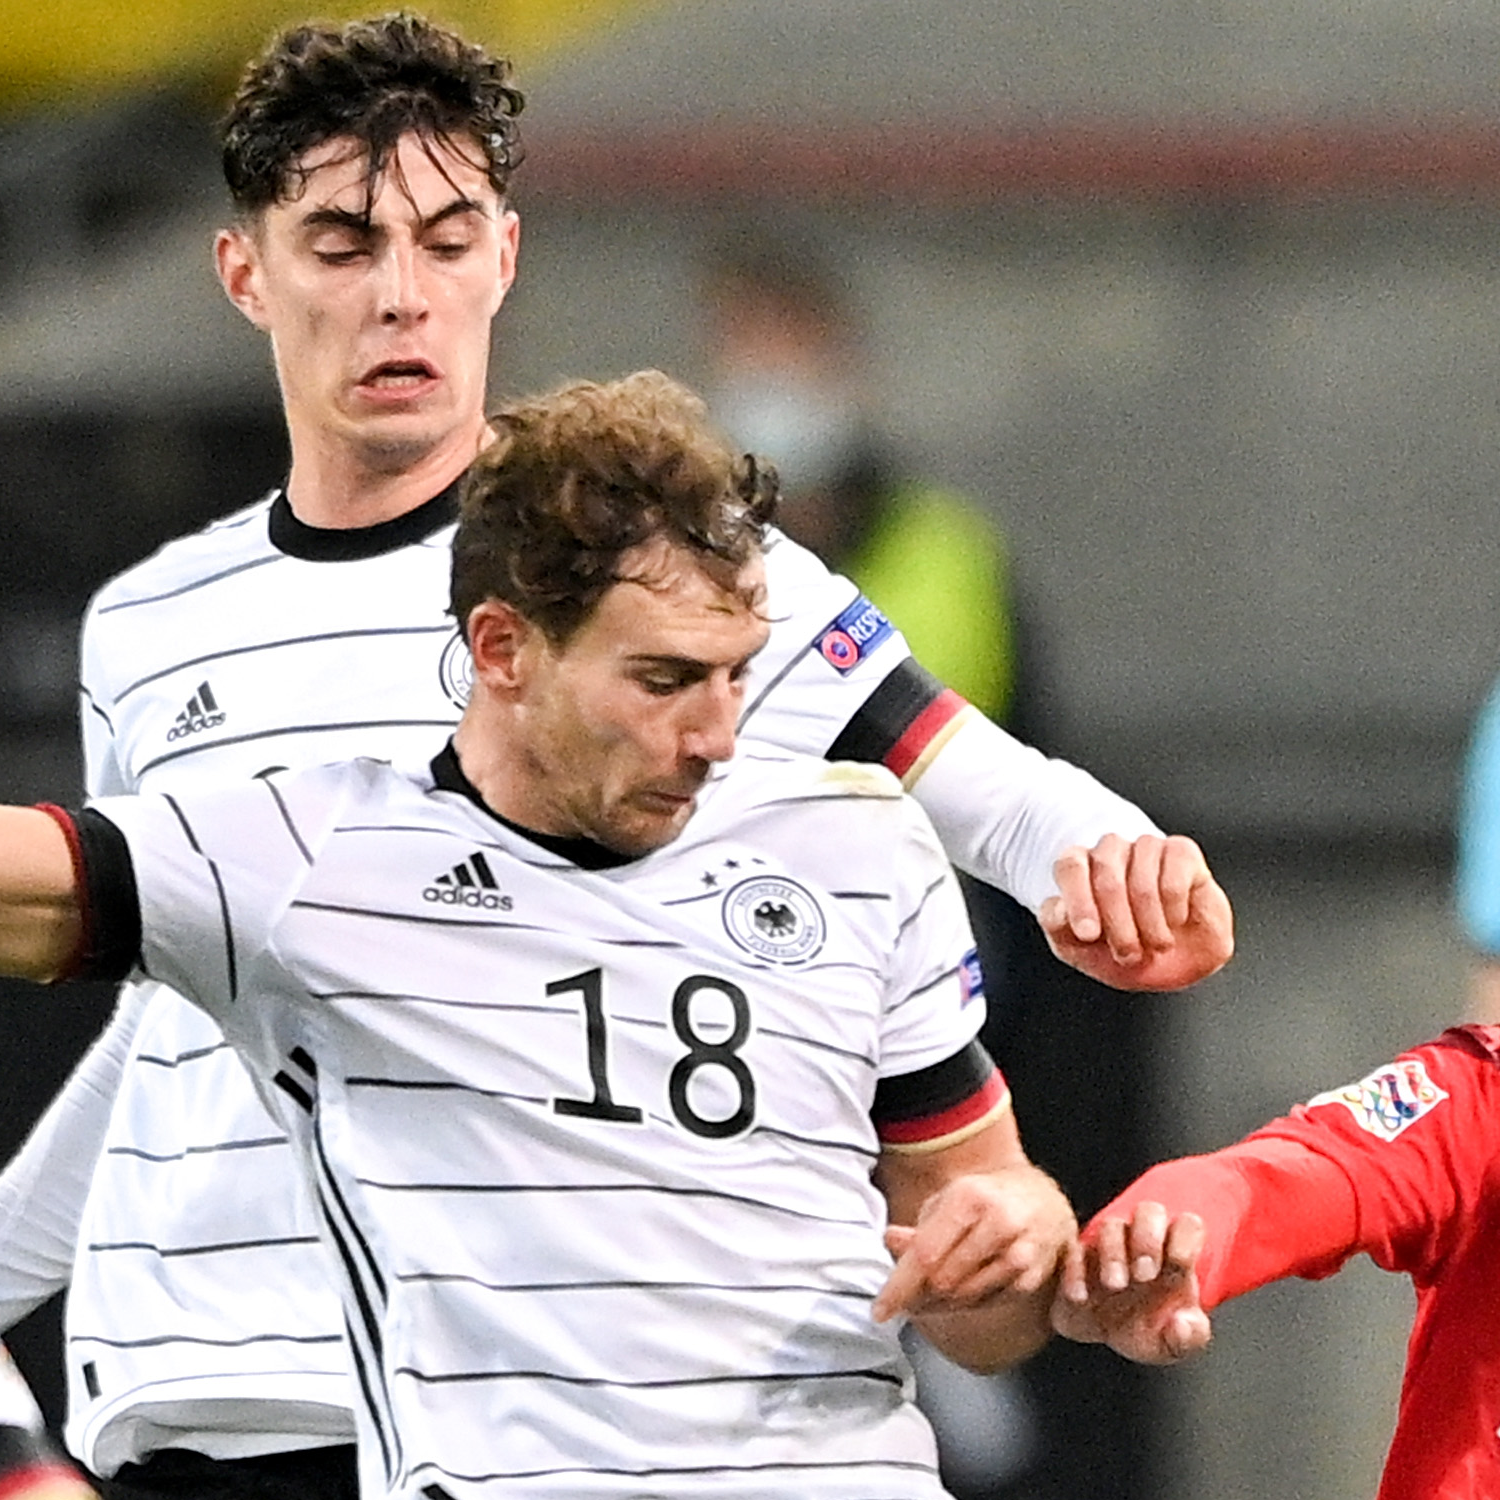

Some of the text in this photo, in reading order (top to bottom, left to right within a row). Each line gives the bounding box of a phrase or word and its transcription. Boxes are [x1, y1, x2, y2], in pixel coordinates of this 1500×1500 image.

[166, 711, 226, 742] adidas
[422, 885, 513, 911] adidas
[544, 966, 757, 1139] 18
